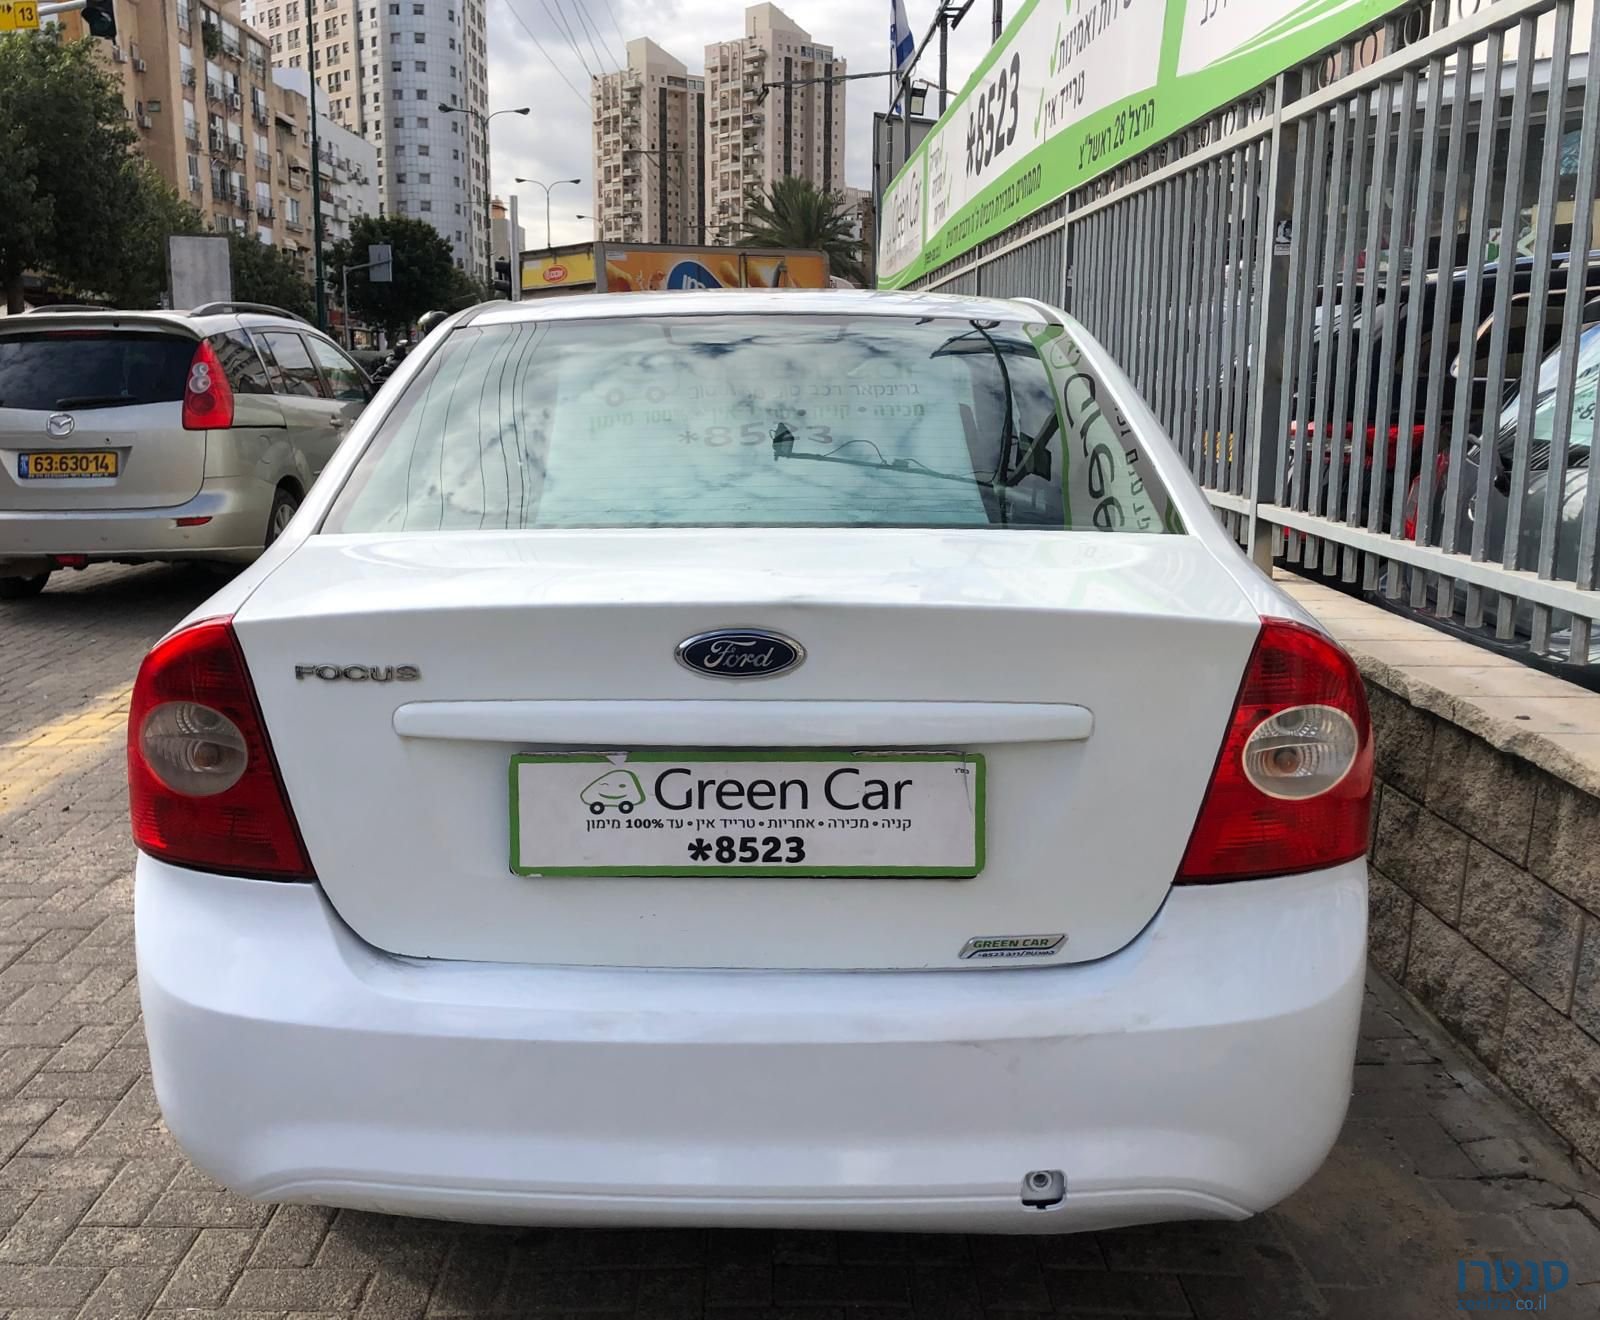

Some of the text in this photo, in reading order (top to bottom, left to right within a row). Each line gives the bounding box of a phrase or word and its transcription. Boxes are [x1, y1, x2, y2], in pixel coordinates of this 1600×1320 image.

[18, 6, 34, 21] 13
[1043, 70, 1085, 144] טרייד אין
[1129, 98, 1155, 140] הרצל
[1113, 110, 1126, 149] 28
[704, 640, 775, 668] Ford
[295, 664, 421, 682] FOCUS
[654, 768, 913, 811] Green Car
[586, 818, 912, 832] קניה מכירה אחריות טרייד אין עד 100% מימון
[973, 938, 1049, 948] GREEN CAR
